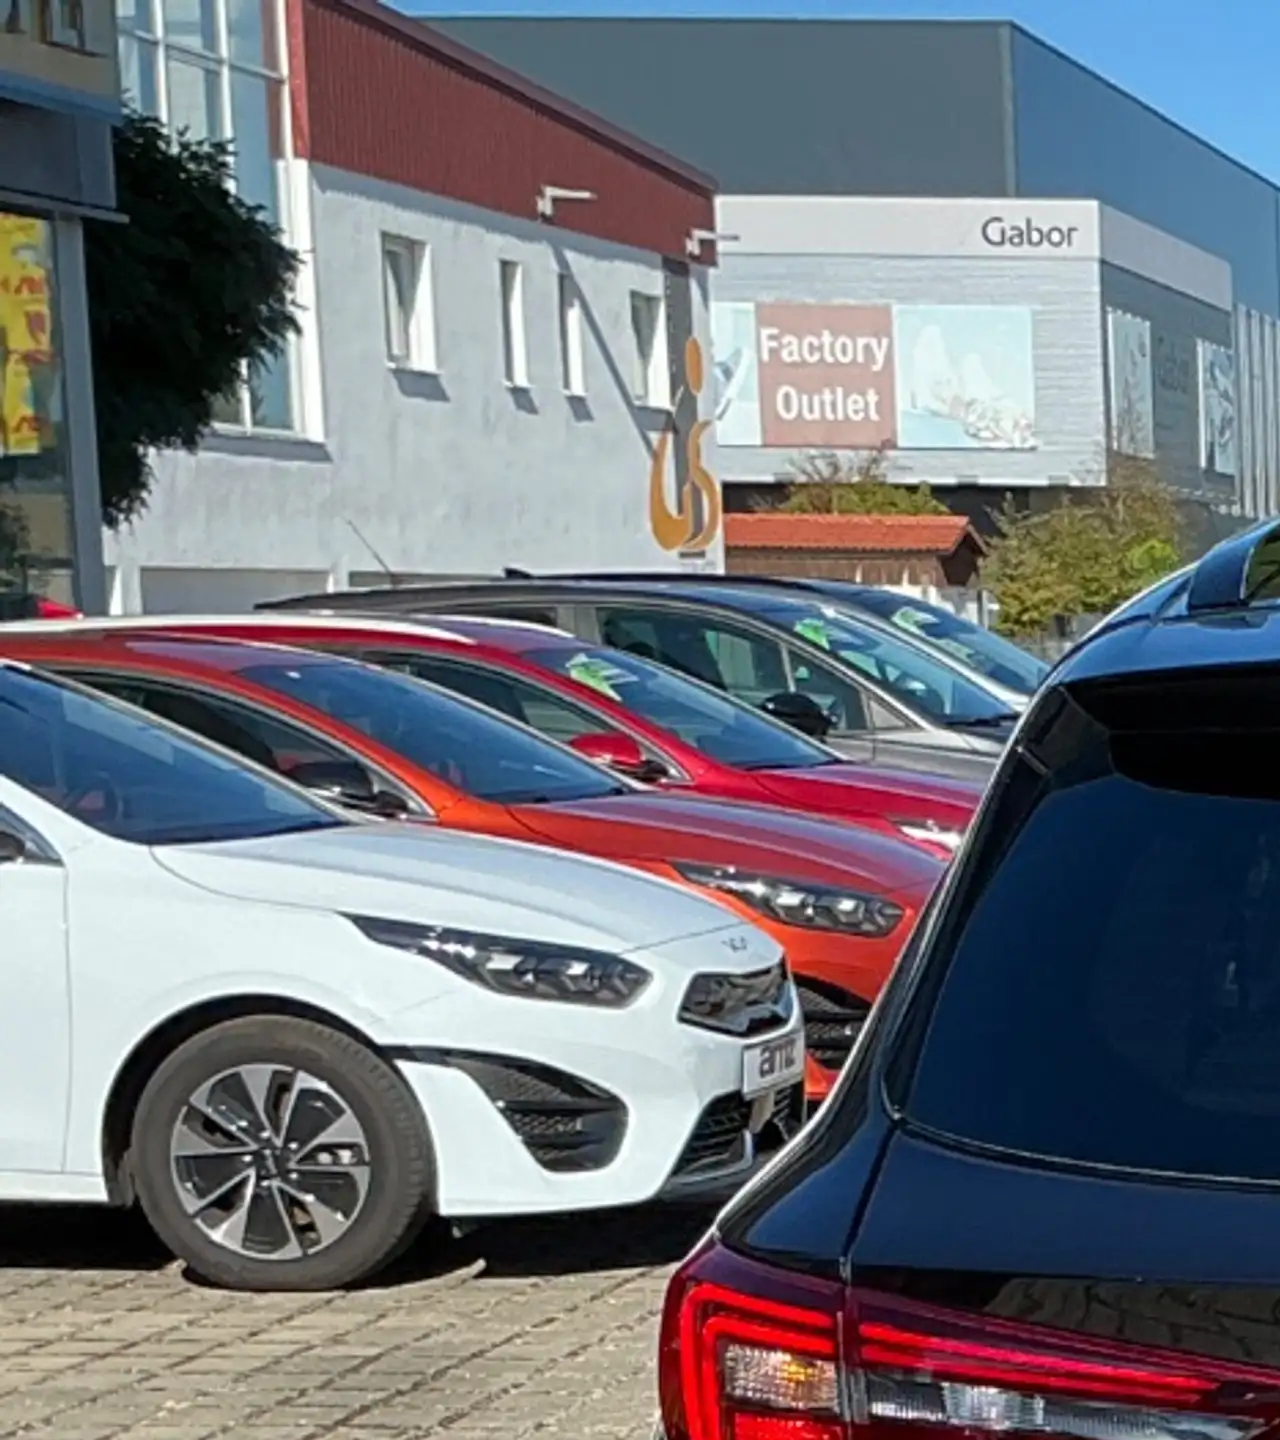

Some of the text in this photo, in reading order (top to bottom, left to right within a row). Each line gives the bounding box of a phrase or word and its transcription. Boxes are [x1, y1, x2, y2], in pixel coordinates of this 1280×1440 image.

[981, 216, 1077, 248] Gabor
[759, 327, 889, 372] Factory
[776, 384, 880, 422] Outlet
